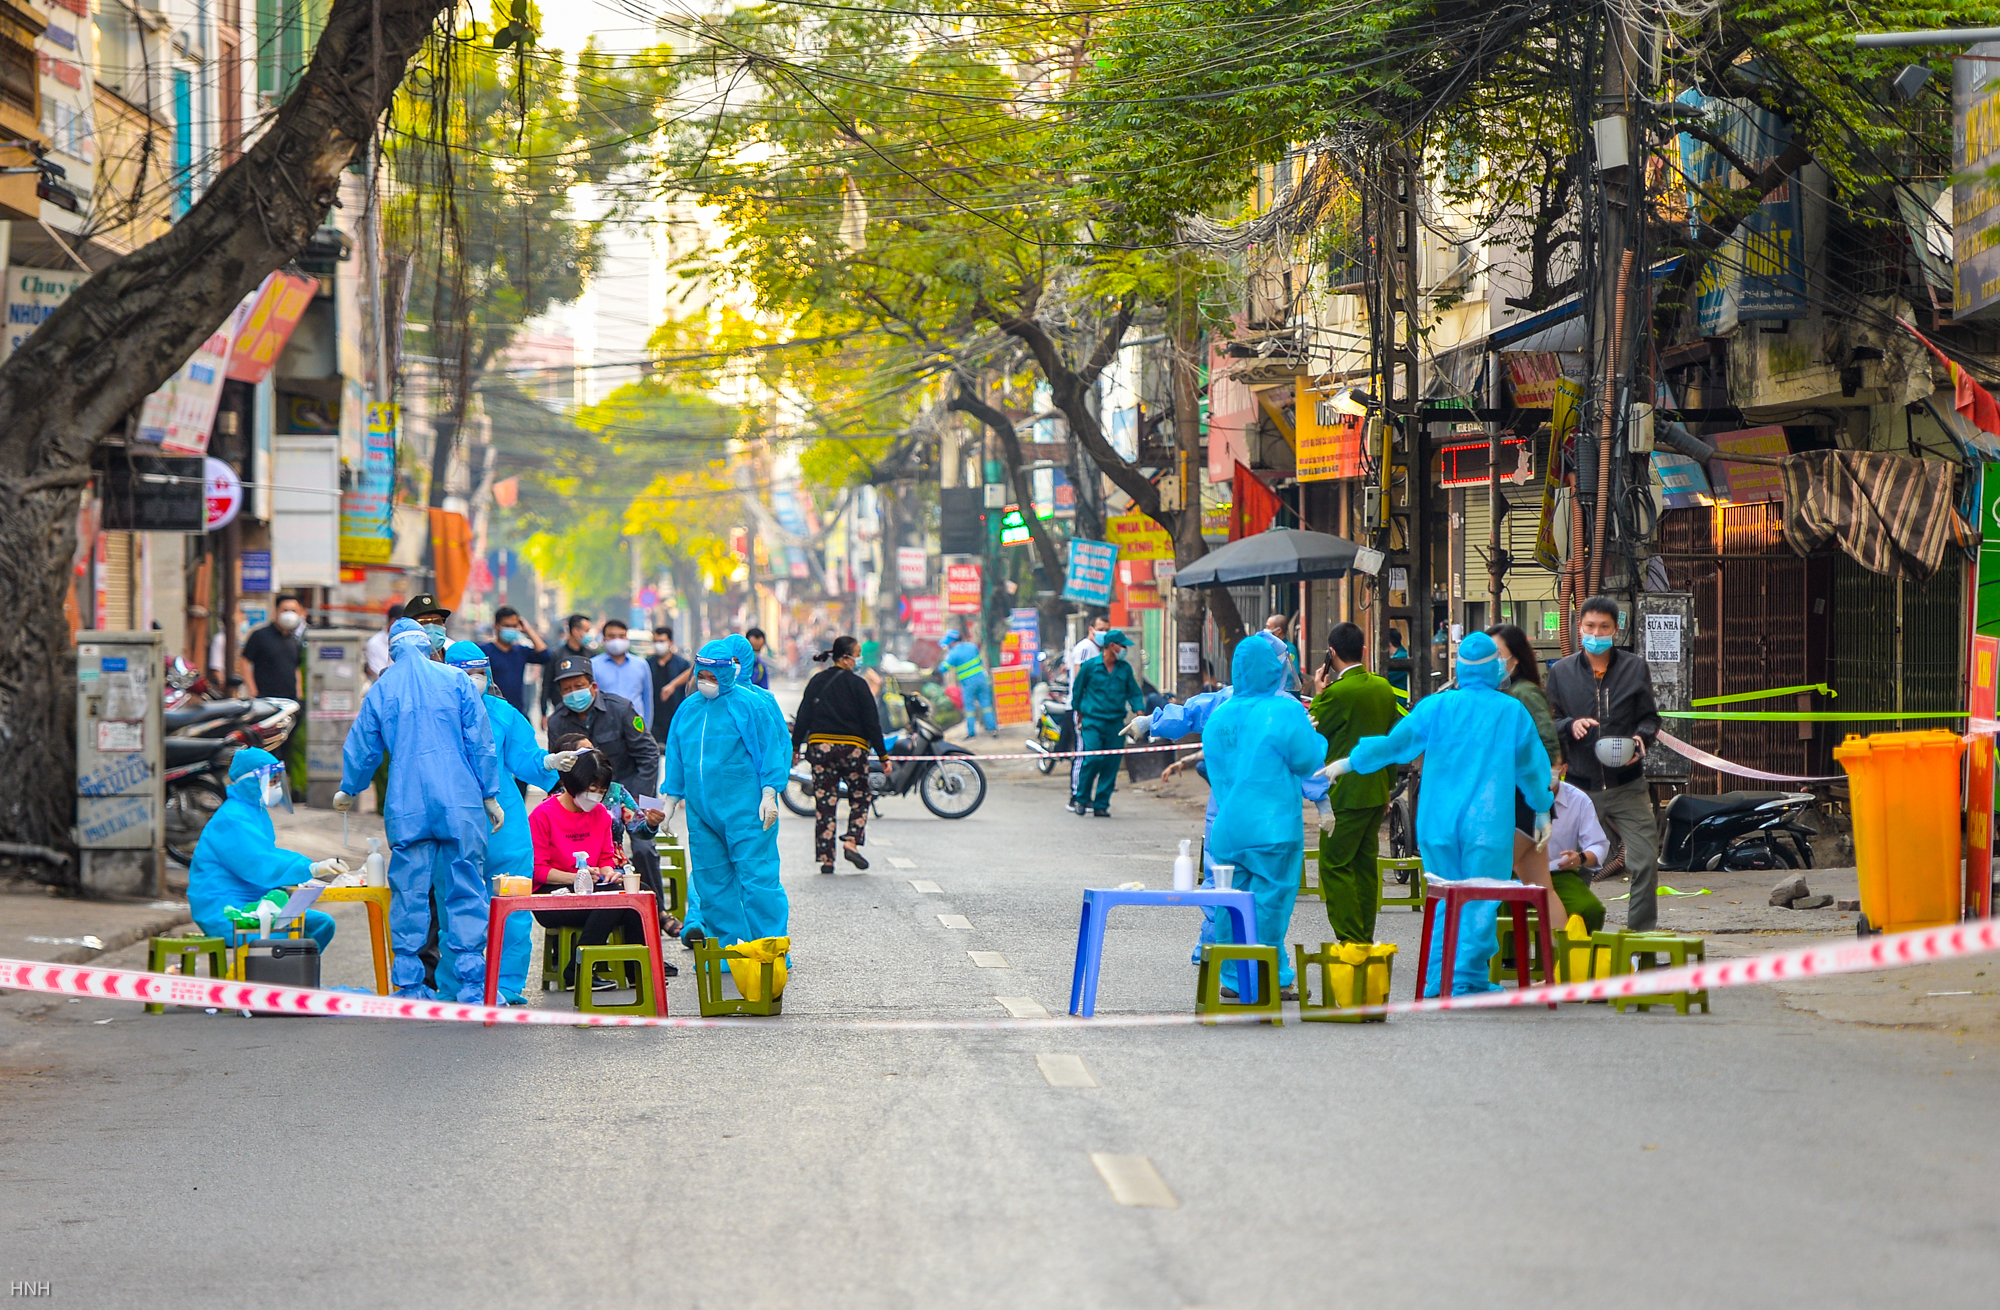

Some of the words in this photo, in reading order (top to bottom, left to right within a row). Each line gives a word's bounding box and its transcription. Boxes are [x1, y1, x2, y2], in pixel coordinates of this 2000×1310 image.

[21, 275, 80, 299] Chuyê
[1647, 619, 1662, 630] SỬA
[1664, 618, 1679, 630] NHÀ
